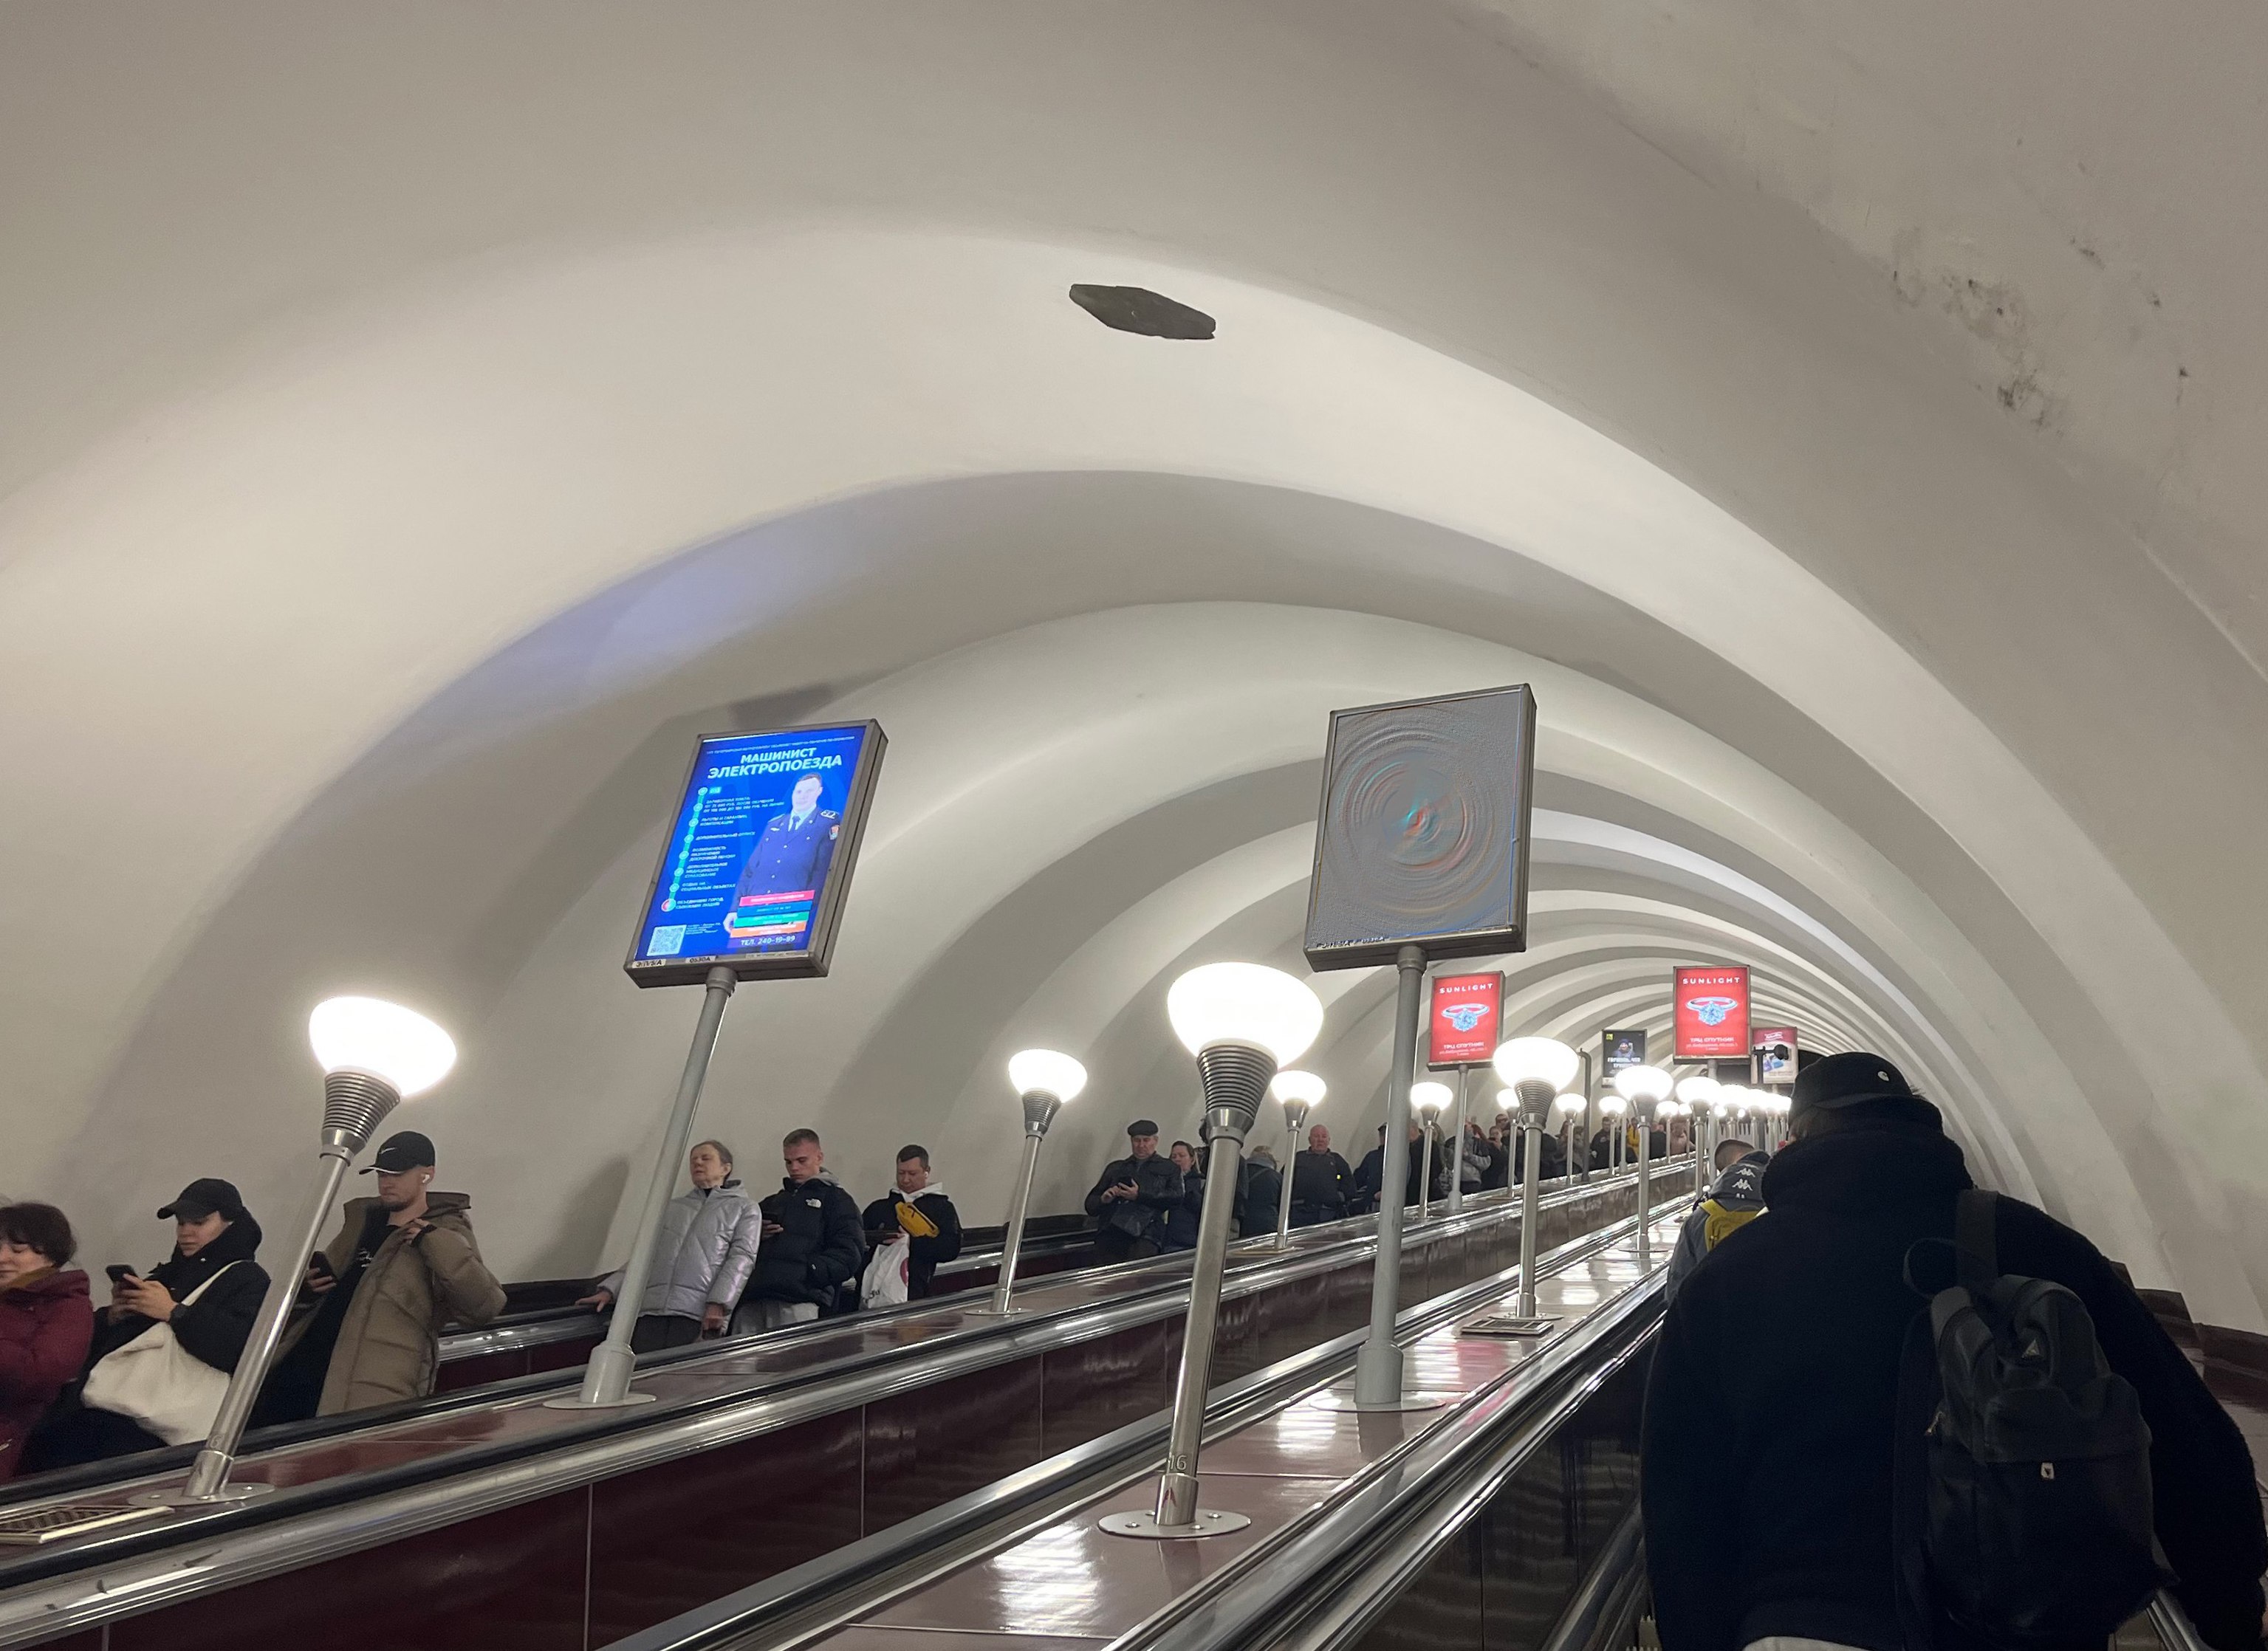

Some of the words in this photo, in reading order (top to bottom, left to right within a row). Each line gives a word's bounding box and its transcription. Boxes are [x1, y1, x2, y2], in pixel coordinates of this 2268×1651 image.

[741, 747, 817, 763] МАШИНИСТ
[708, 755, 842, 779] ЭЛЕКТРОПОЕЗДА
[1439, 983, 1493, 994] SUNLIGHT
[1169, 1455, 1188, 1471] 16
